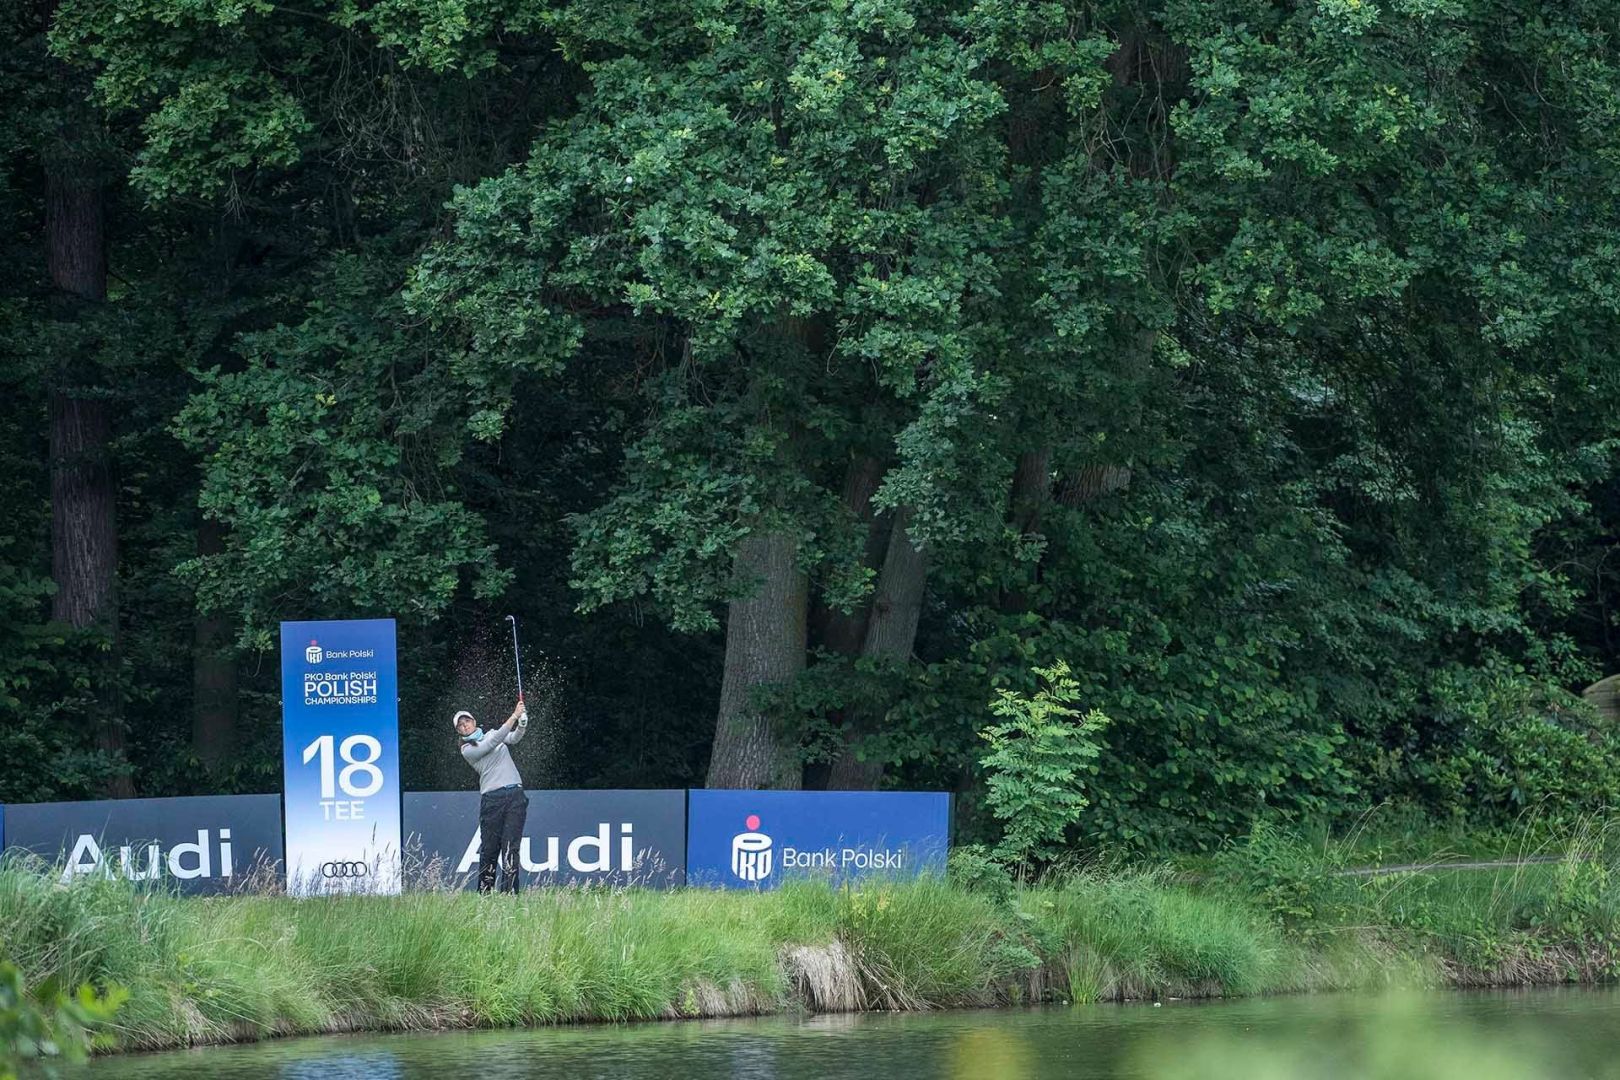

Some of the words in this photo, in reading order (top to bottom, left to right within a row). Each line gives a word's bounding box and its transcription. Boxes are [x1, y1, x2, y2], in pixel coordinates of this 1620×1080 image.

[326, 651, 348, 659] Bank
[349, 649, 374, 658] Polski
[304, 673, 323, 681] PKO
[325, 672, 348, 680] Bank
[350, 671, 377, 680] Polski
[304, 680, 377, 697] POLISH
[304, 696, 377, 705] CHAMPIONSHIPS
[303, 734, 384, 798] 18
[320, 801, 364, 820] TEE
[60, 828, 233, 884] Audi
[783, 848, 836, 868] Bank
[842, 849, 902, 869] Polski
